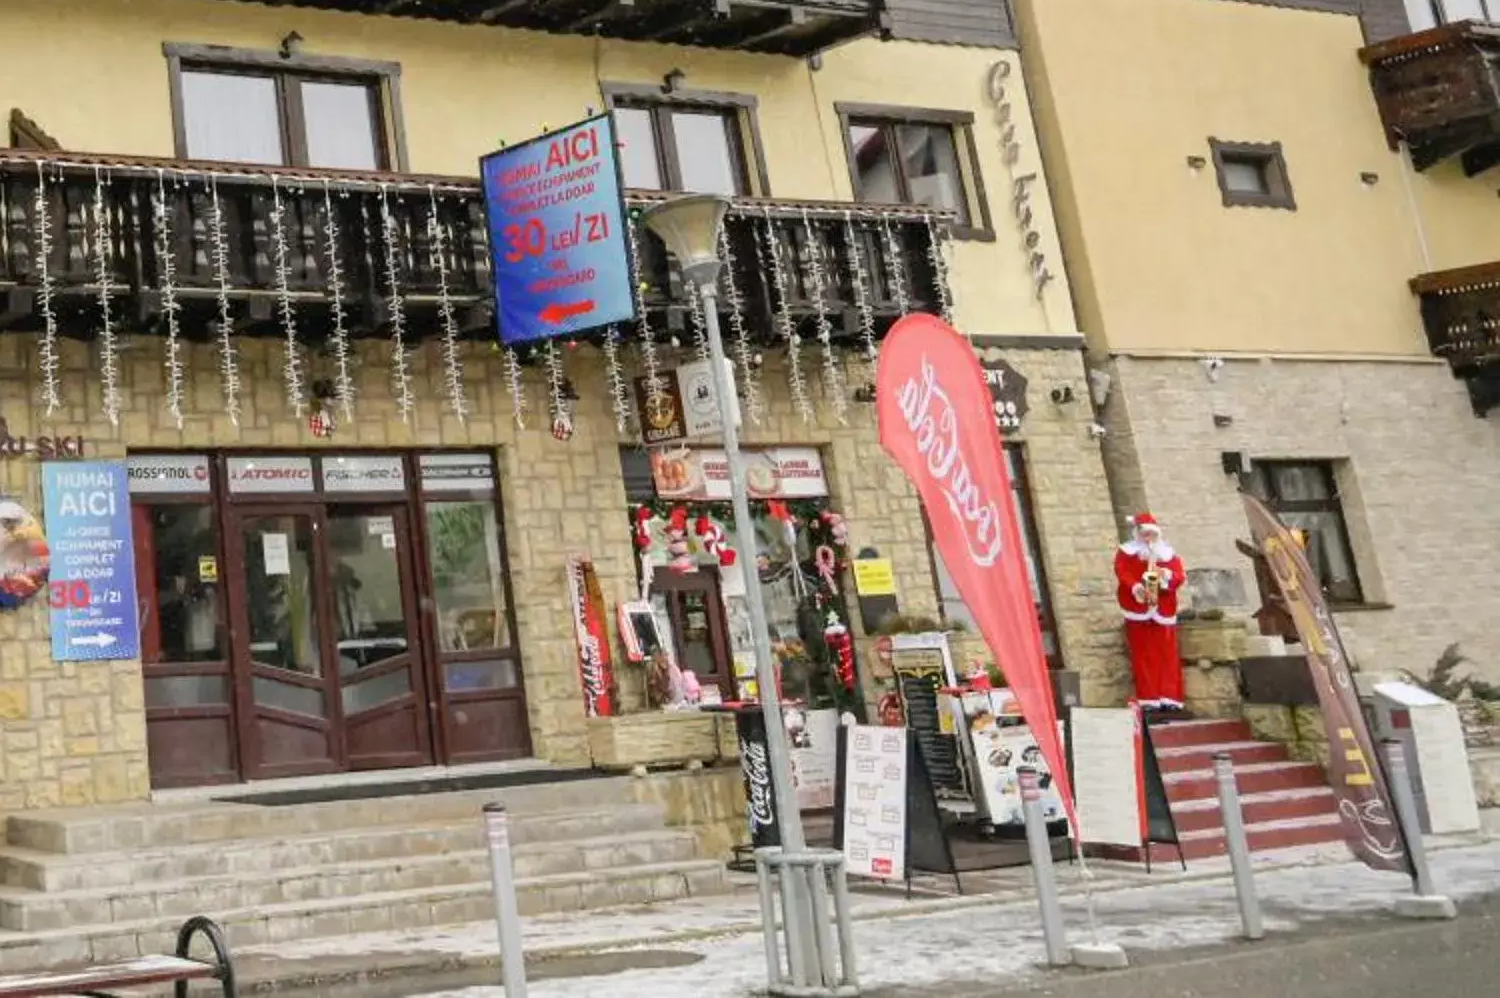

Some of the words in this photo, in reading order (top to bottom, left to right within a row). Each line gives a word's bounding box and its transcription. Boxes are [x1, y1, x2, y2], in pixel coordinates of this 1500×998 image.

[545, 127, 600, 172] AICI
[503, 217, 547, 263] 30
[56, 472, 114, 490] NUMAI
[241, 468, 311, 480] ATOMIC
[59, 491, 116, 517] AICI
[49, 579, 90, 609] 30
[740, 739, 772, 827] Coca-Cola
